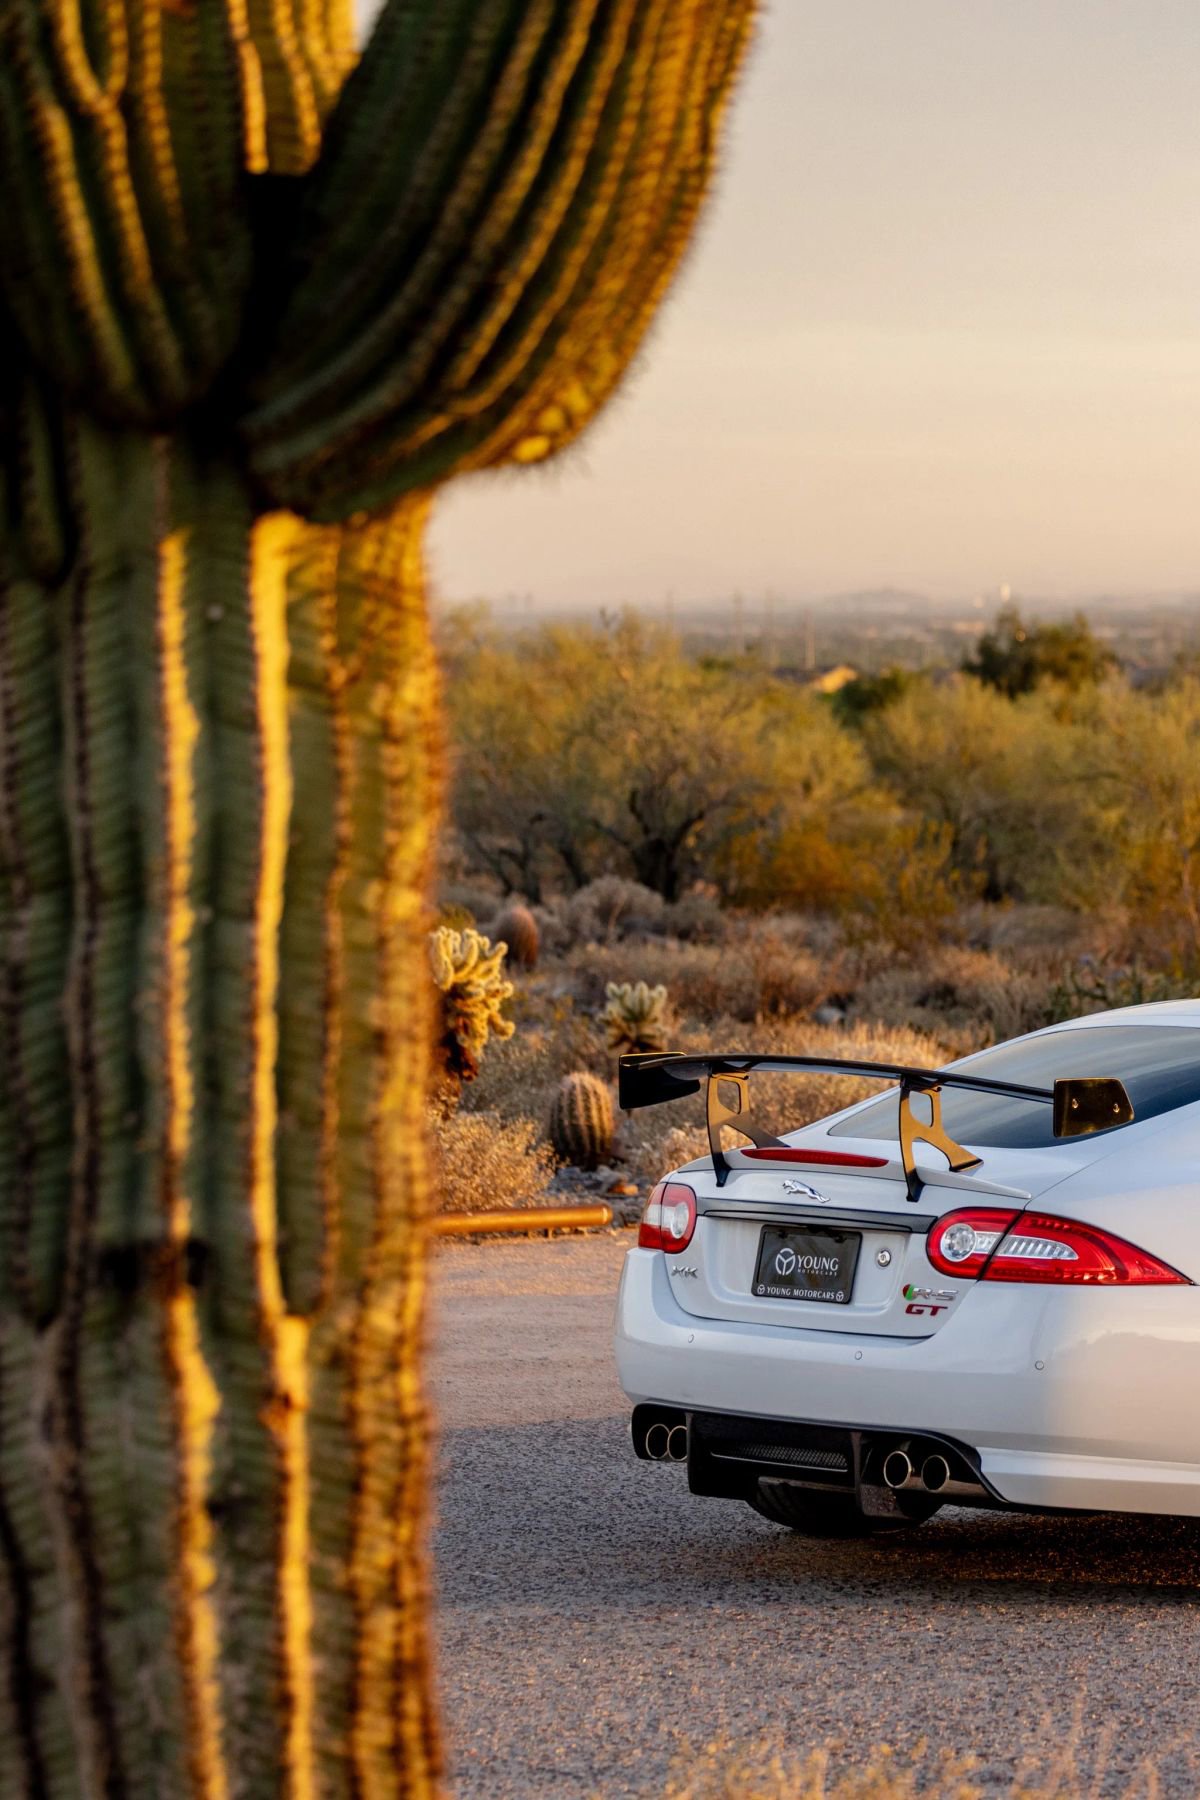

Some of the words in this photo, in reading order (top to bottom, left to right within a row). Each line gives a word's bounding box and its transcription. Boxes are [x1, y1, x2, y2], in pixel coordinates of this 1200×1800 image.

[797, 1255, 839, 1271] YOUNG
[797, 1269, 838, 1277] MOTORCARS
[766, 1286, 791, 1296] YOUNG
[793, 1288, 835, 1300] MOTORCARS
[905, 1303, 948, 1316] GT
